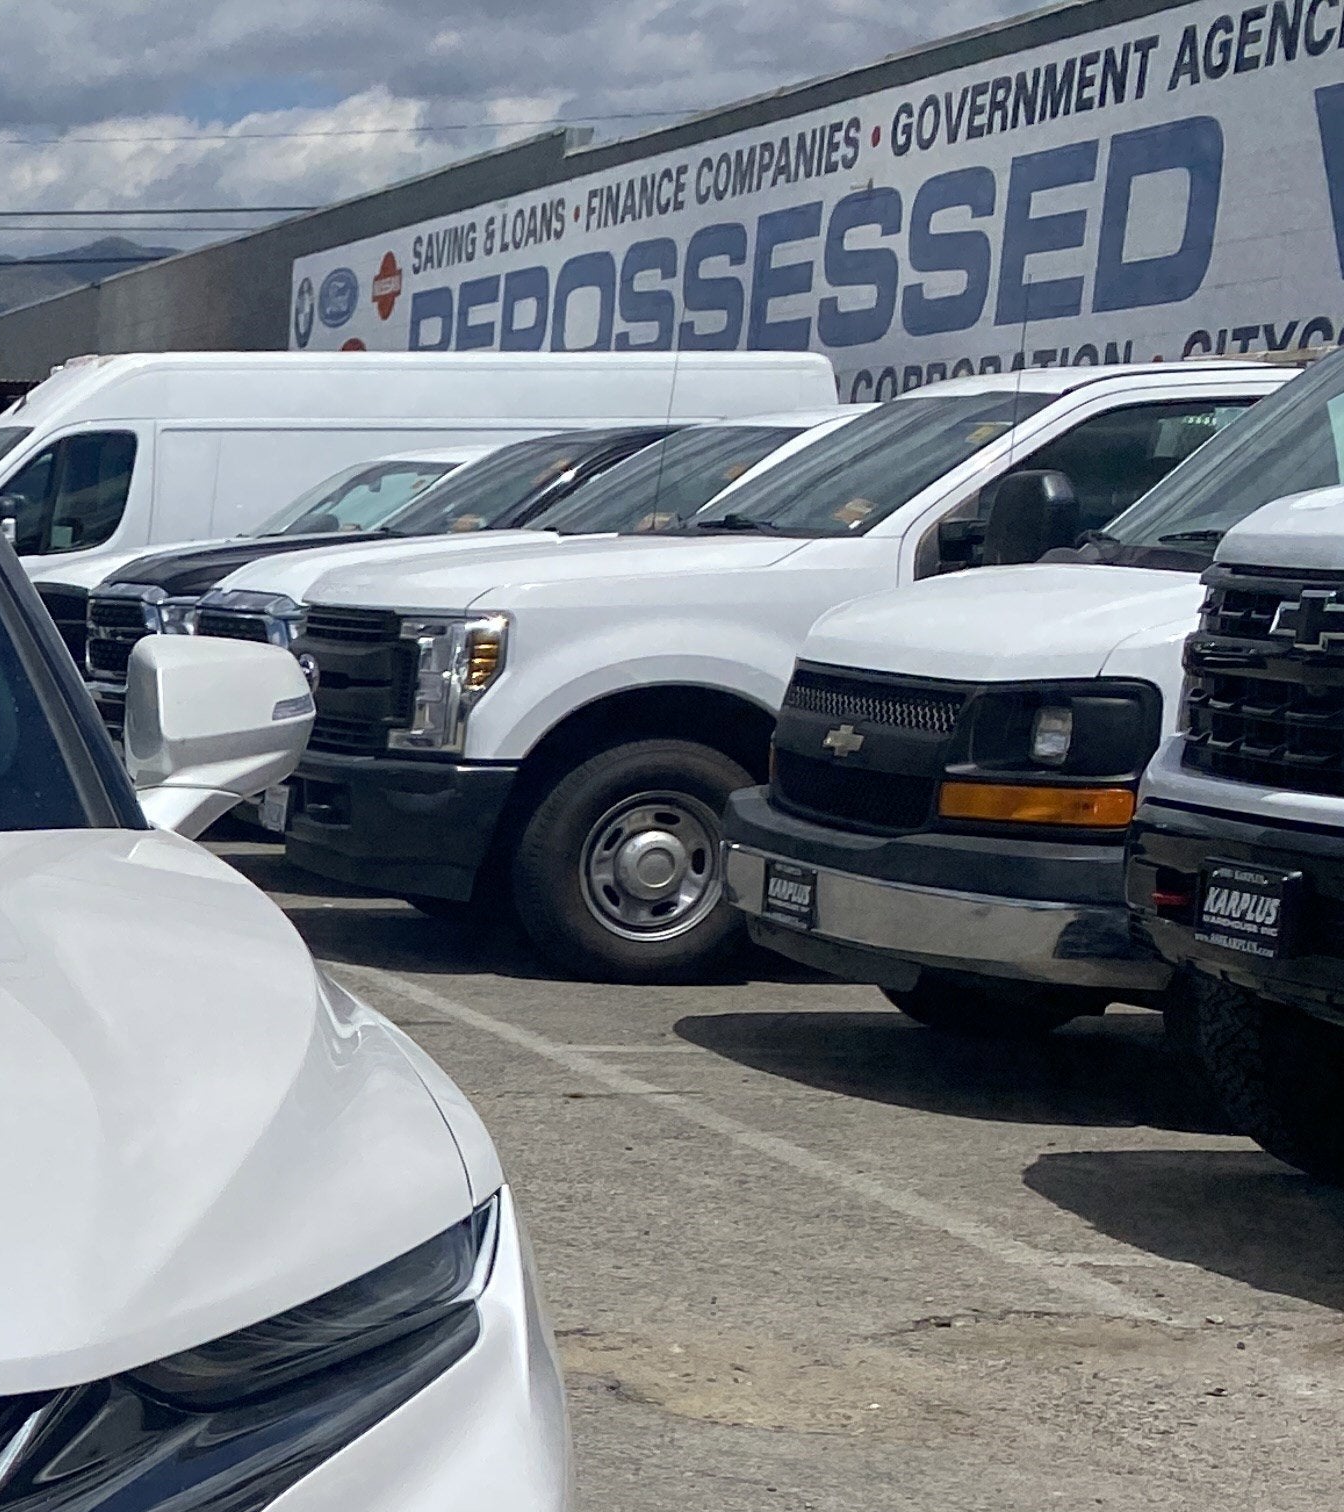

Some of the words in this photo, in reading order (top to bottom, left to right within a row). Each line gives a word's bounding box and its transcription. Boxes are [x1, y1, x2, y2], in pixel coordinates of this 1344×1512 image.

[412, 221, 478, 275] SAVING
[483, 215, 496, 257] &
[500, 198, 566, 253] LOANS
[585, 164, 689, 233] FINANCE
[696, 116, 861, 205] COMPANIES
[890, 35, 1160, 157] GOVERNMENT
[1204, 886, 1281, 925] KARPLUS
